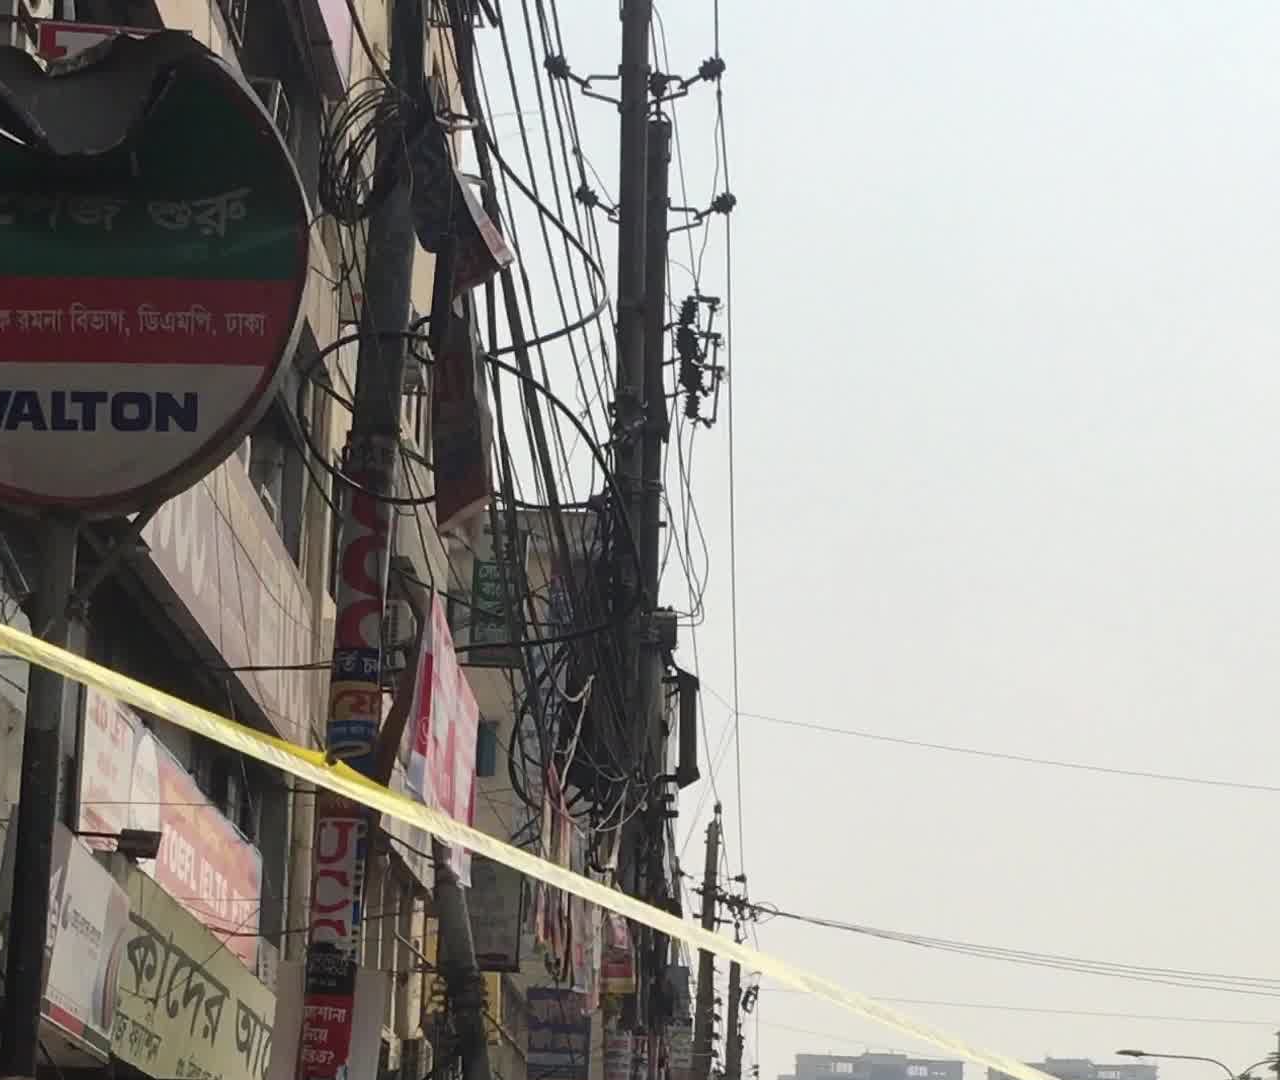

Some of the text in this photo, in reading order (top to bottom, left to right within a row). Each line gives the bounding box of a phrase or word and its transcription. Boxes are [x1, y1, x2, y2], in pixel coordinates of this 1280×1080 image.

[15, 309, 63, 334] রমনা
[224, 311, 266, 335] ঢাকা
[161, 823, 197, 892] TOEFL
[128, 910, 231, 1049] কাদের
